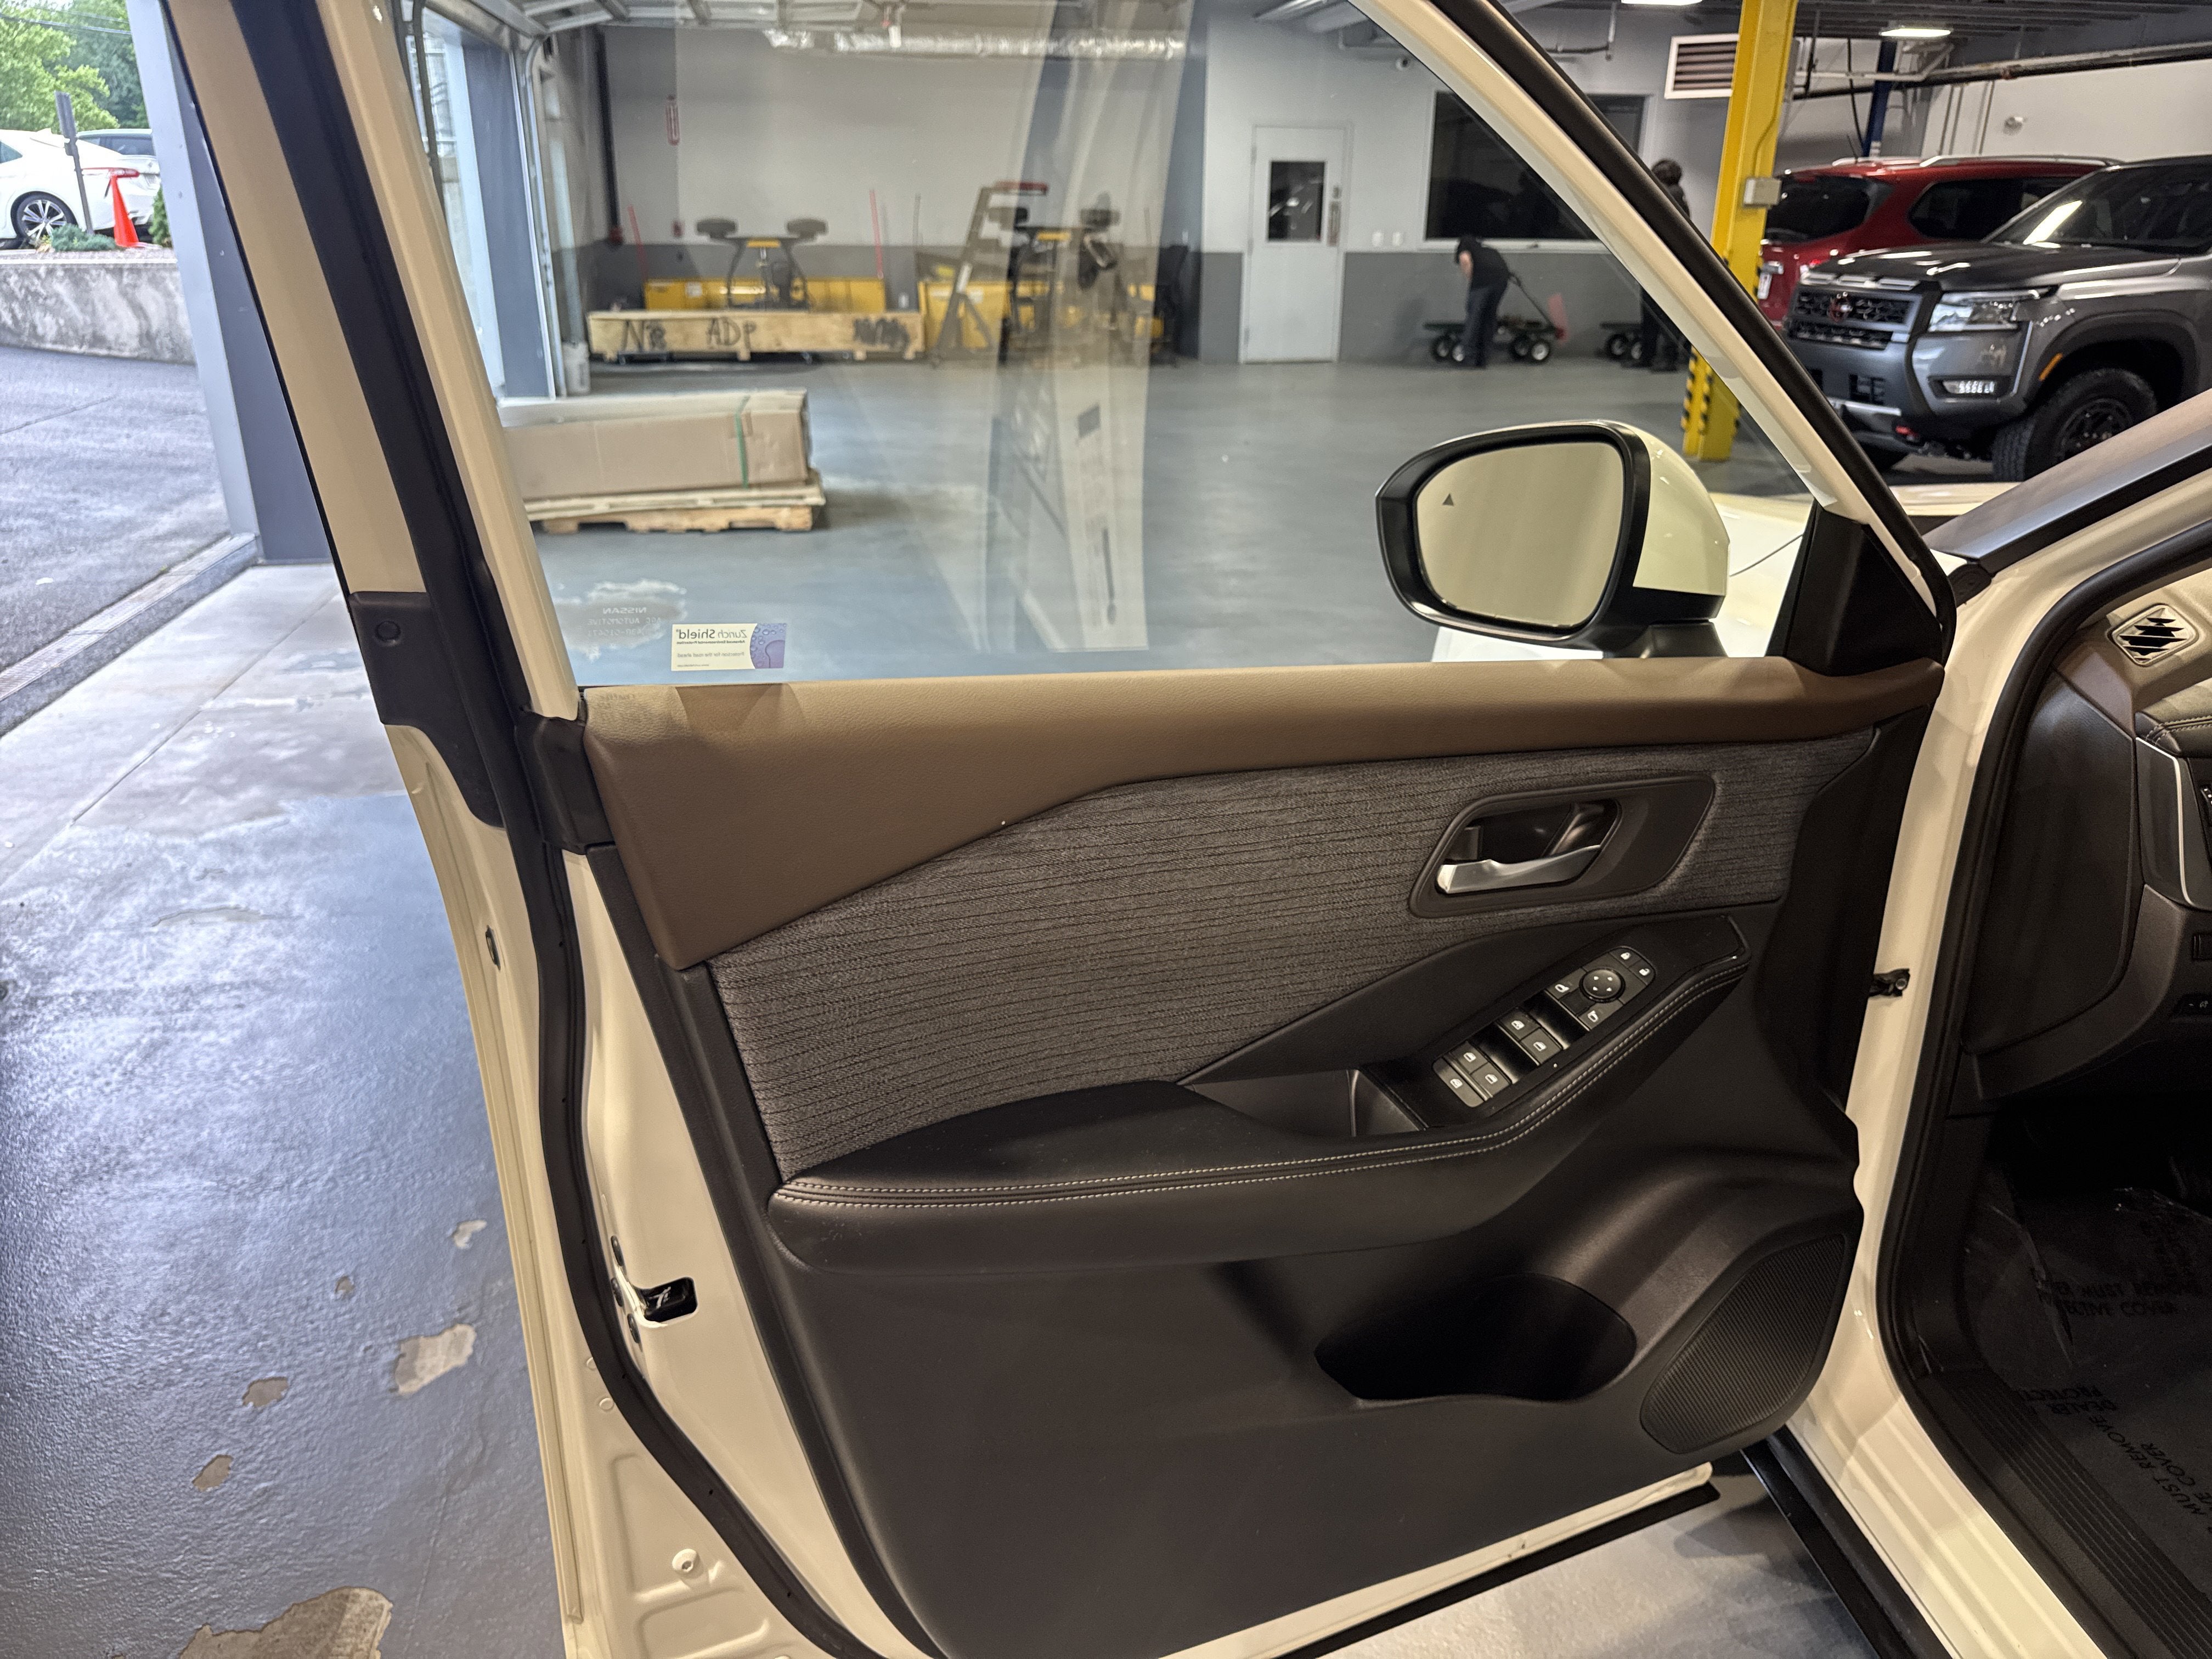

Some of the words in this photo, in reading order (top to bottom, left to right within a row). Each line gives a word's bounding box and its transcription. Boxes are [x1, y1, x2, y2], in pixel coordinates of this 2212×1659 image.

[2089, 1415, 2156, 1469] REMOVE
[2140, 1442, 2197, 1487] COVER
[2152, 1476, 2207, 1515] MUST
